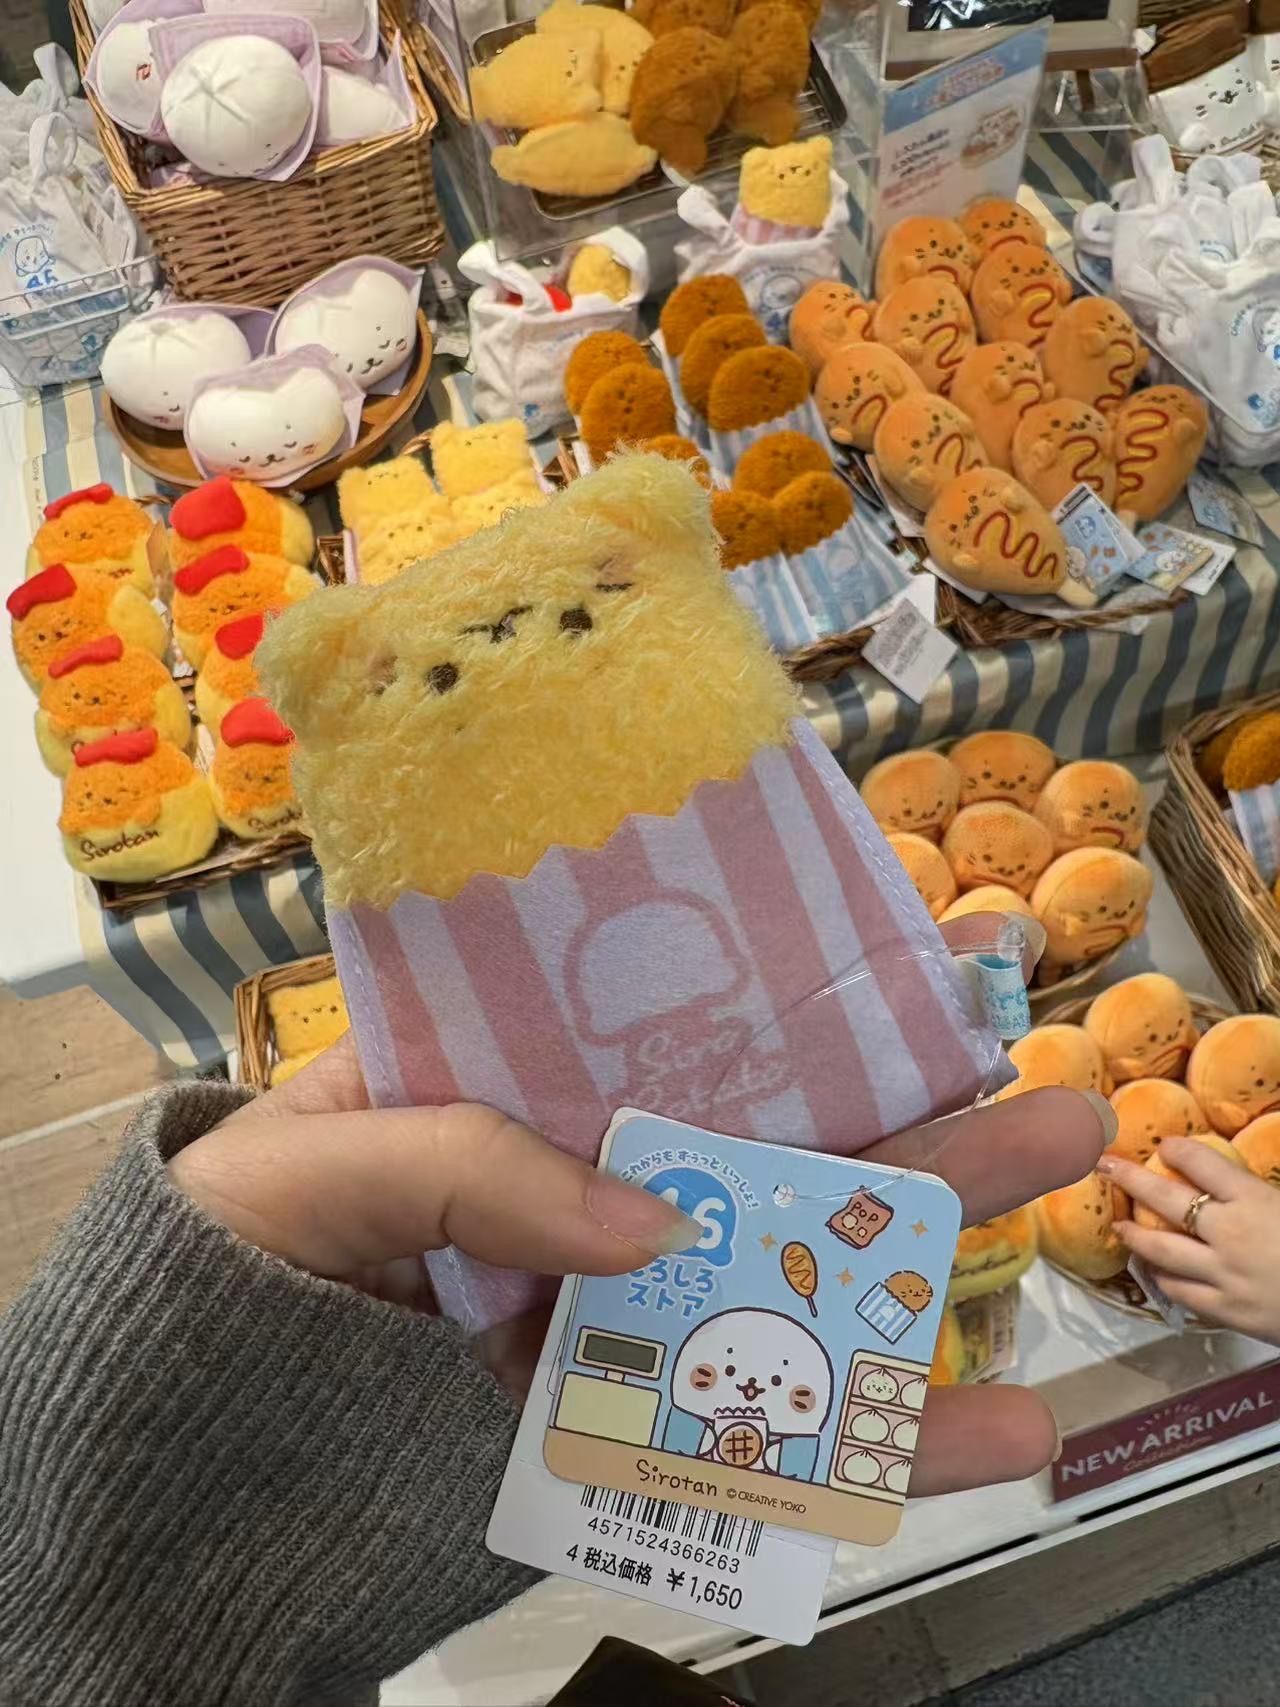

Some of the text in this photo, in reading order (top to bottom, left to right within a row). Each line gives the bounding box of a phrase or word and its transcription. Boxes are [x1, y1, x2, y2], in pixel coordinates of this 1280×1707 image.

[626, 1282, 706, 1317] ストア
[1062, 1391, 1273, 1482] NEW ARRIVAL
[636, 1458, 717, 1497] Sirotan
[780, 1499, 807, 1514] YOKO
[587, 1516, 741, 1574] 4571524366263
[566, 1544, 743, 1610] 4 税込価格 ¥1,650
